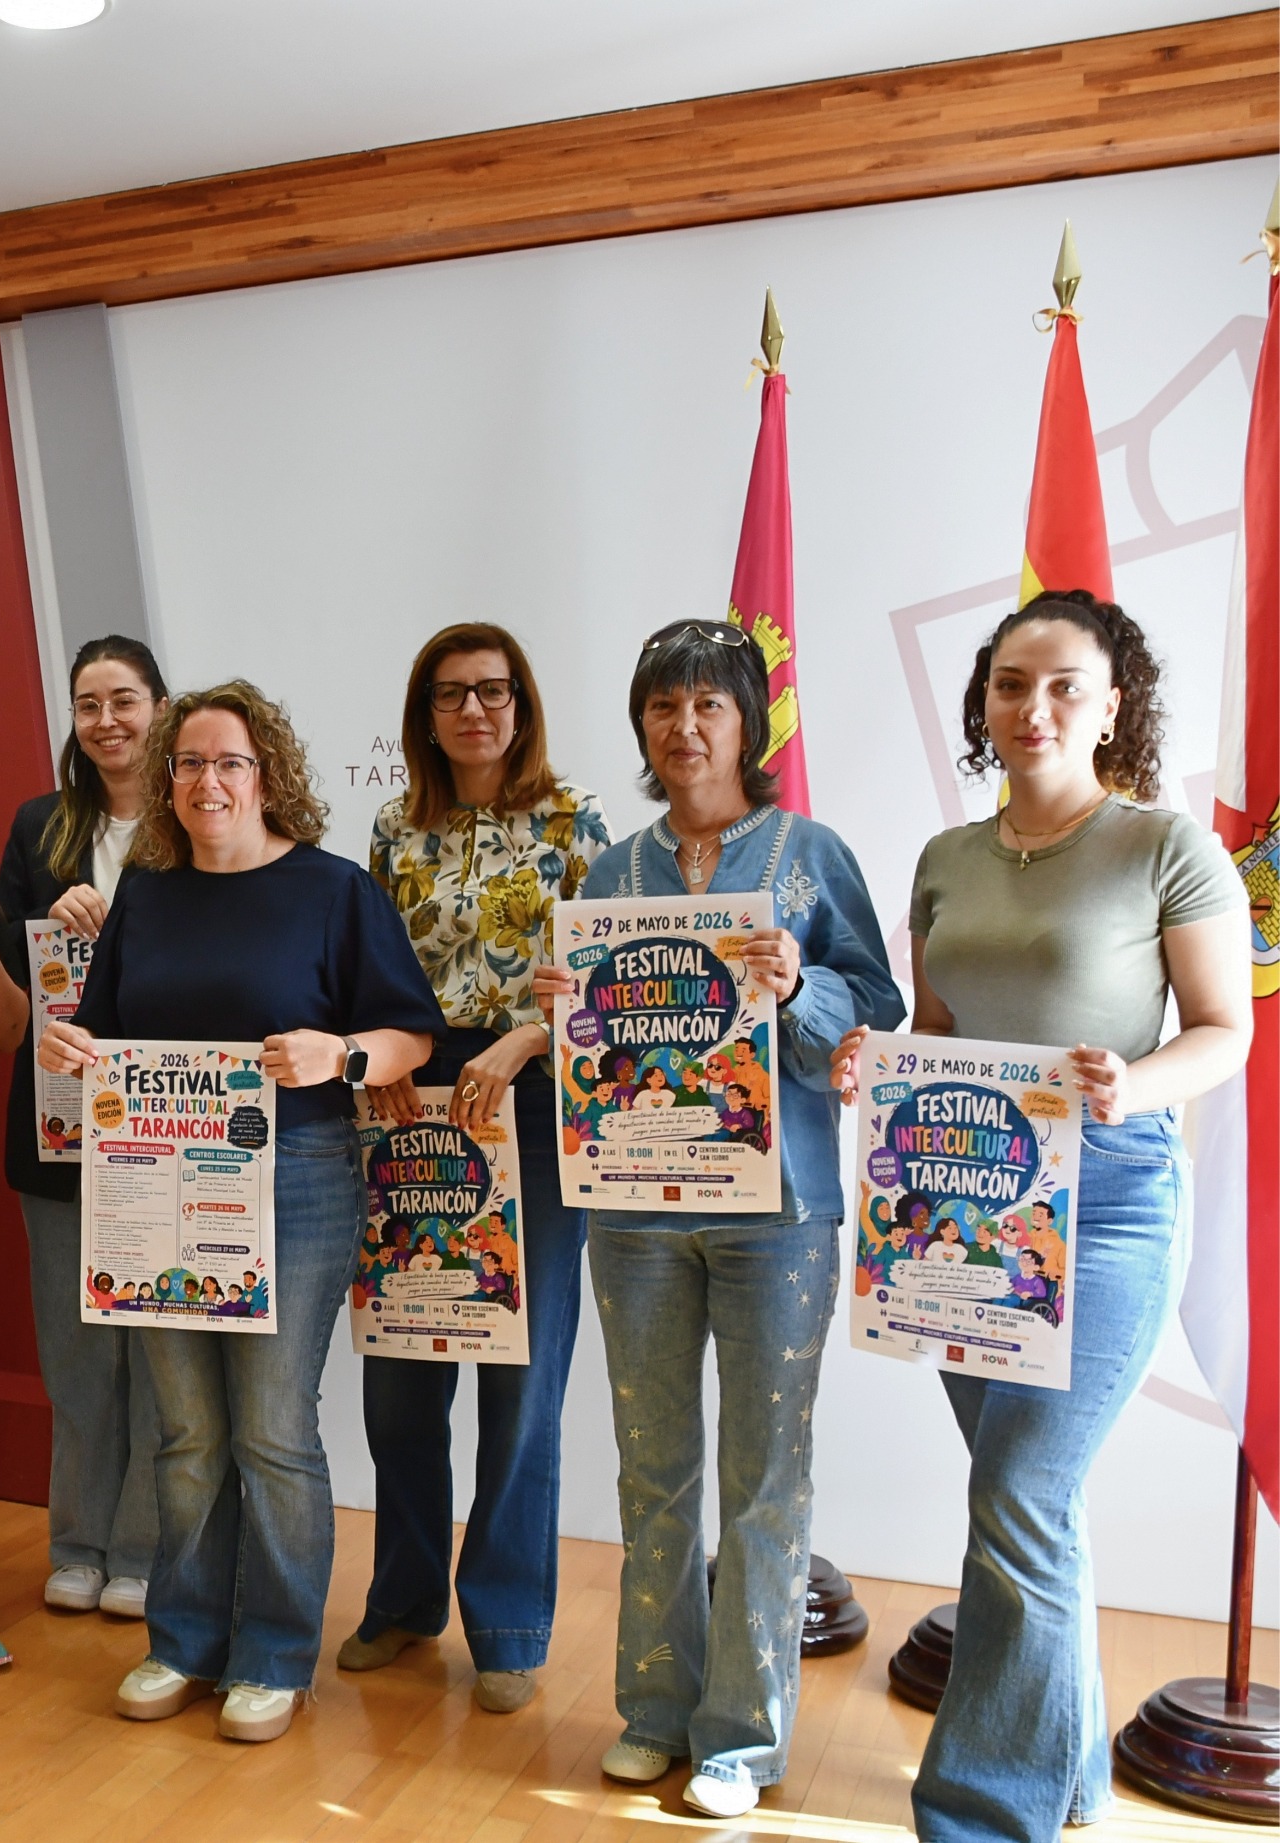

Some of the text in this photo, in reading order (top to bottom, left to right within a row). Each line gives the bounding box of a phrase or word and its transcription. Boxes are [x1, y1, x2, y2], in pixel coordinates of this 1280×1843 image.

[345, 766, 407, 786] TAR
[592, 911, 732, 937] 29 DE MAYO DE 2026
[576, 949, 603, 965] 2026
[614, 945, 709, 981] FESTIVAL
[43, 968, 64, 978] NOVENA
[45, 977, 66, 987] EDICIÓN
[594, 979, 731, 1012] INTERCULTURAL
[571, 1017, 596, 1029] NOVENA
[607, 1009, 720, 1045] TARANCÓN
[573, 1027, 597, 1038] EDICIÓN
[161, 1053, 189, 1067] 2026
[897, 1054, 1040, 1083] 29 DE MAYO DE 2026
[125, 1064, 227, 1096] FESTIVAL
[879, 1086, 906, 1100] 2026
[95, 1099, 120, 1109] NOVENA
[128, 1097, 230, 1115] INTERCULTURAL
[436, 1104, 448, 1116] DE
[917, 1090, 1013, 1131] FESTIVAL
[98, 1109, 122, 1119] EDICIÓN
[129, 1116, 225, 1140] TARANCÓN
[130, 1146, 171, 1154] INTERCULTURAL
[390, 1129, 467, 1159] FESTIVAL
[894, 1125, 1032, 1165] INTERCULTURAL
[190, 1151, 247, 1161] CENTROS ESCOLARES
[627, 1148, 653, 1158] 18:00H
[720, 1145, 745, 1153] ESCÉNICO
[872, 1157, 895, 1166] NOVENA
[375, 1159, 485, 1185] INTERCULTURAL
[873, 1165, 896, 1176] EDICIÓN
[906, 1161, 1019, 1201] TARANCÓN
[387, 1186, 477, 1214] TARANCÓN
[698, 1189, 722, 1198] ROVA
[915, 1299, 940, 1313] 18:00H
[982, 1354, 1008, 1366] ROVA
